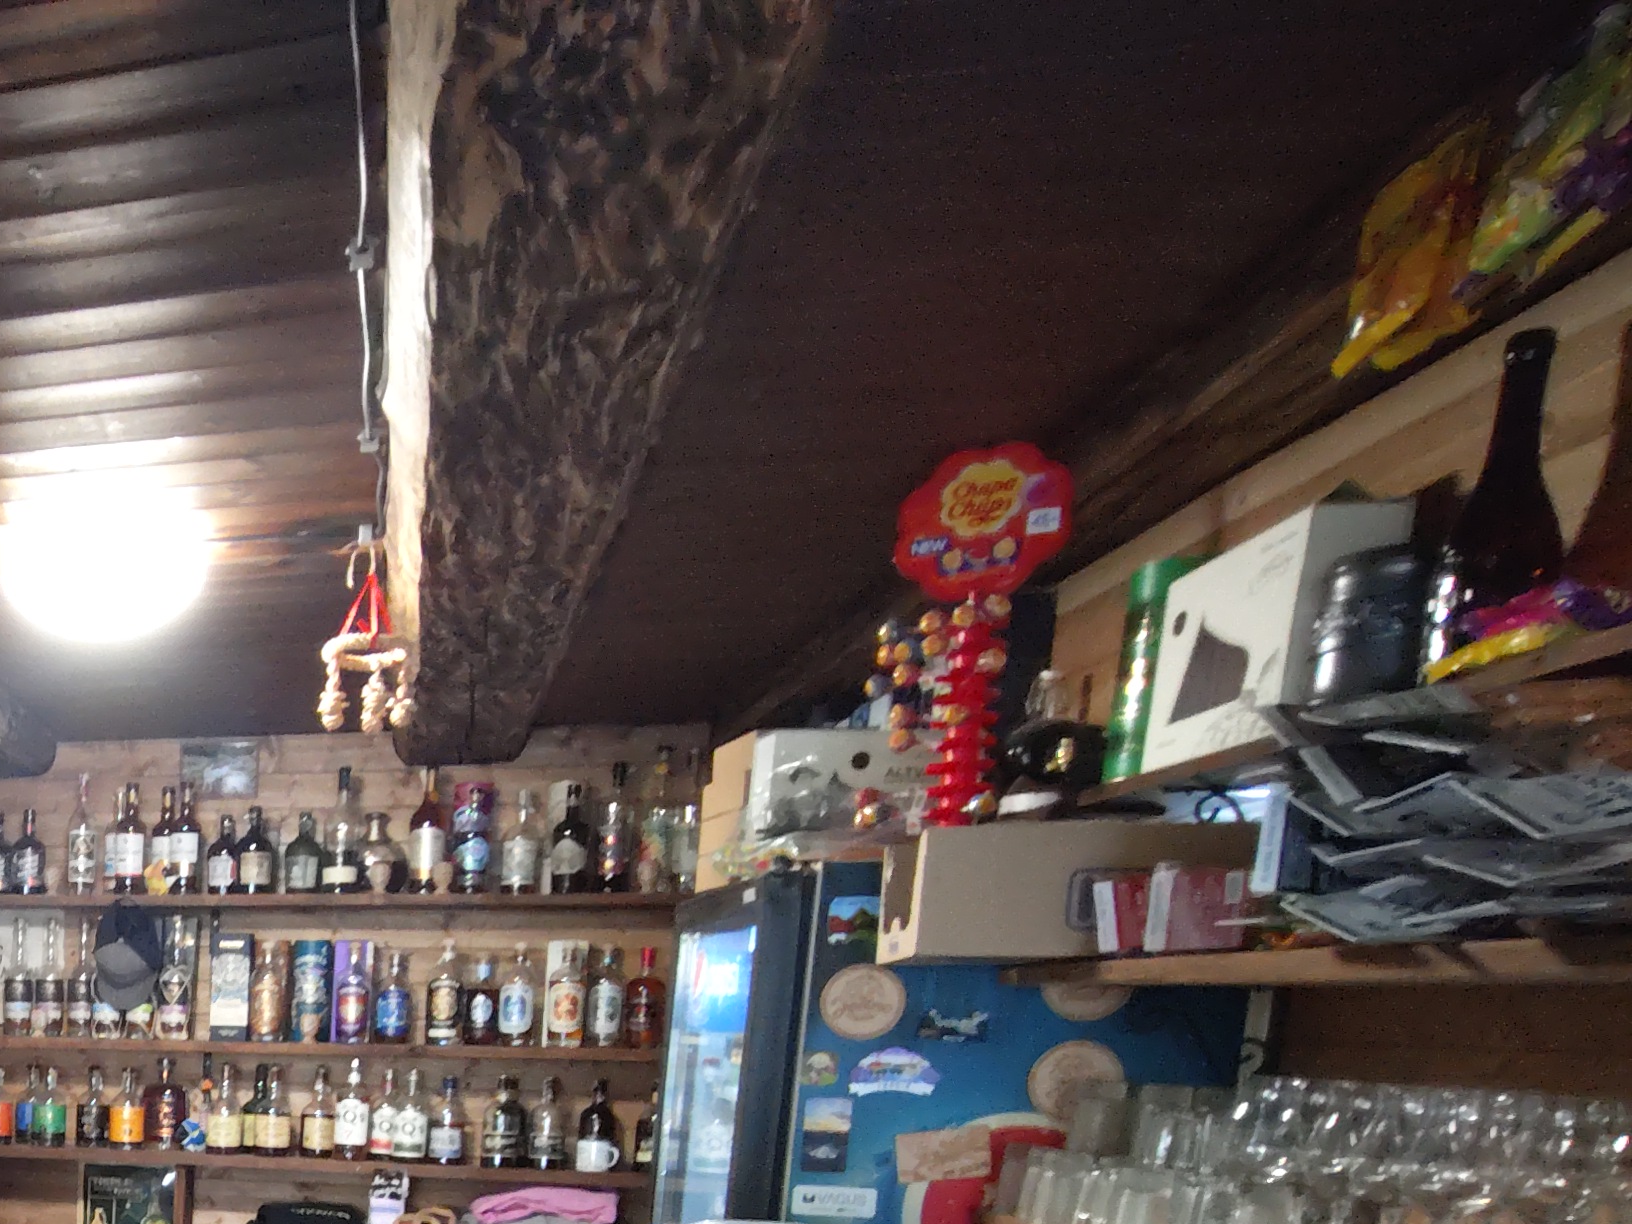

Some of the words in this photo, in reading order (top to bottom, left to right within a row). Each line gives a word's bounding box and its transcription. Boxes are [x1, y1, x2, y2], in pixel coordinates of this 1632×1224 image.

[952, 476, 1019, 500] Chupa
[947, 497, 1013, 522] Chups
[911, 537, 950, 556] NEW
